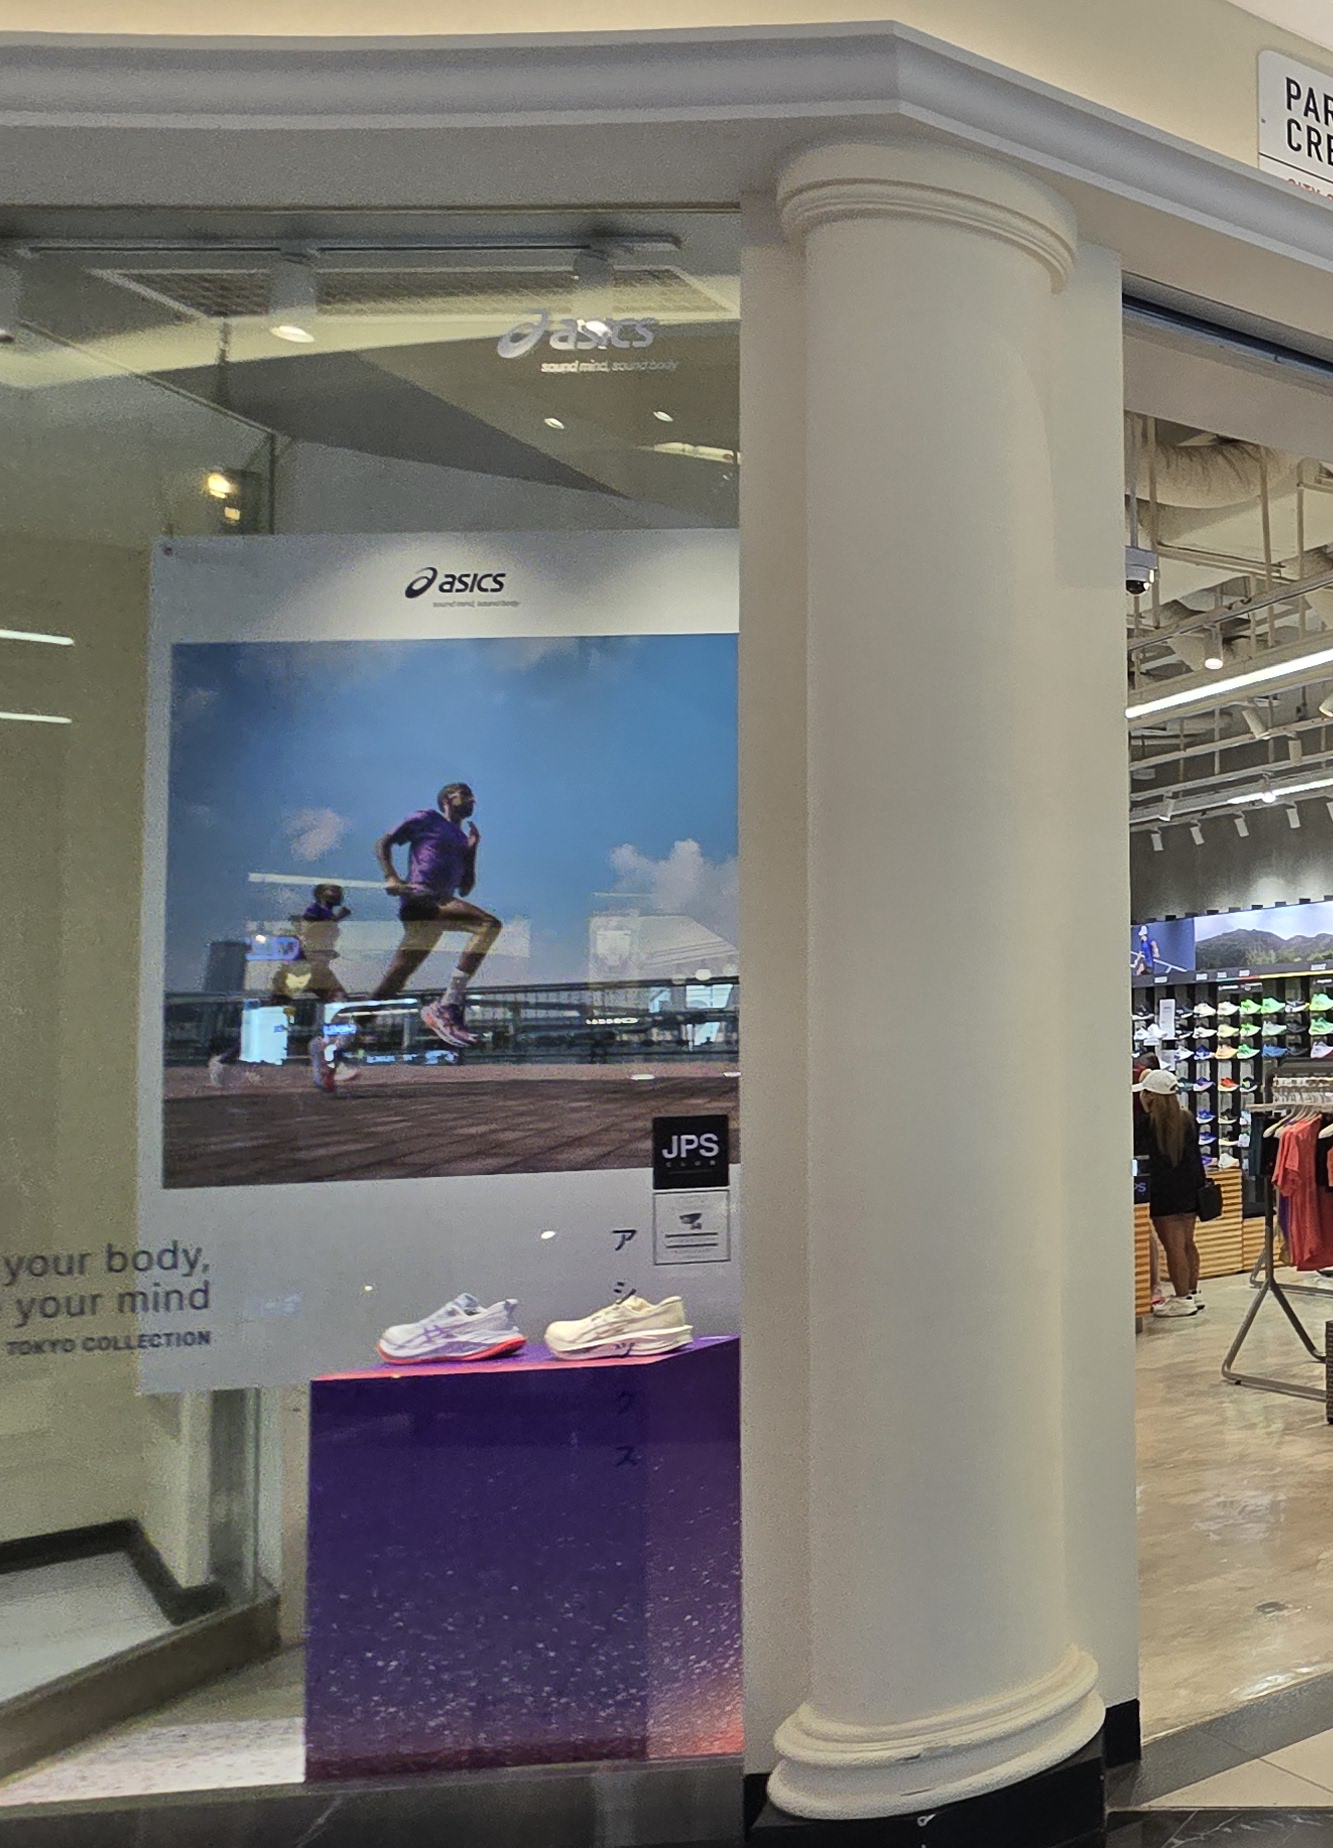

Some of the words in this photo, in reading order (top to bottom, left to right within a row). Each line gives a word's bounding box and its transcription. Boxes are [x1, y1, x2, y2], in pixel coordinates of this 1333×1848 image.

[662, 1133, 719, 1159] JPS
[3, 1251, 92, 1286] your
[104, 1239, 210, 1277] body,
[14, 1293, 103, 1329] your
[117, 1279, 210, 1314] mind
[6, 1338, 76, 1356] TOKYO
[82, 1330, 211, 1351] COLLECTION
